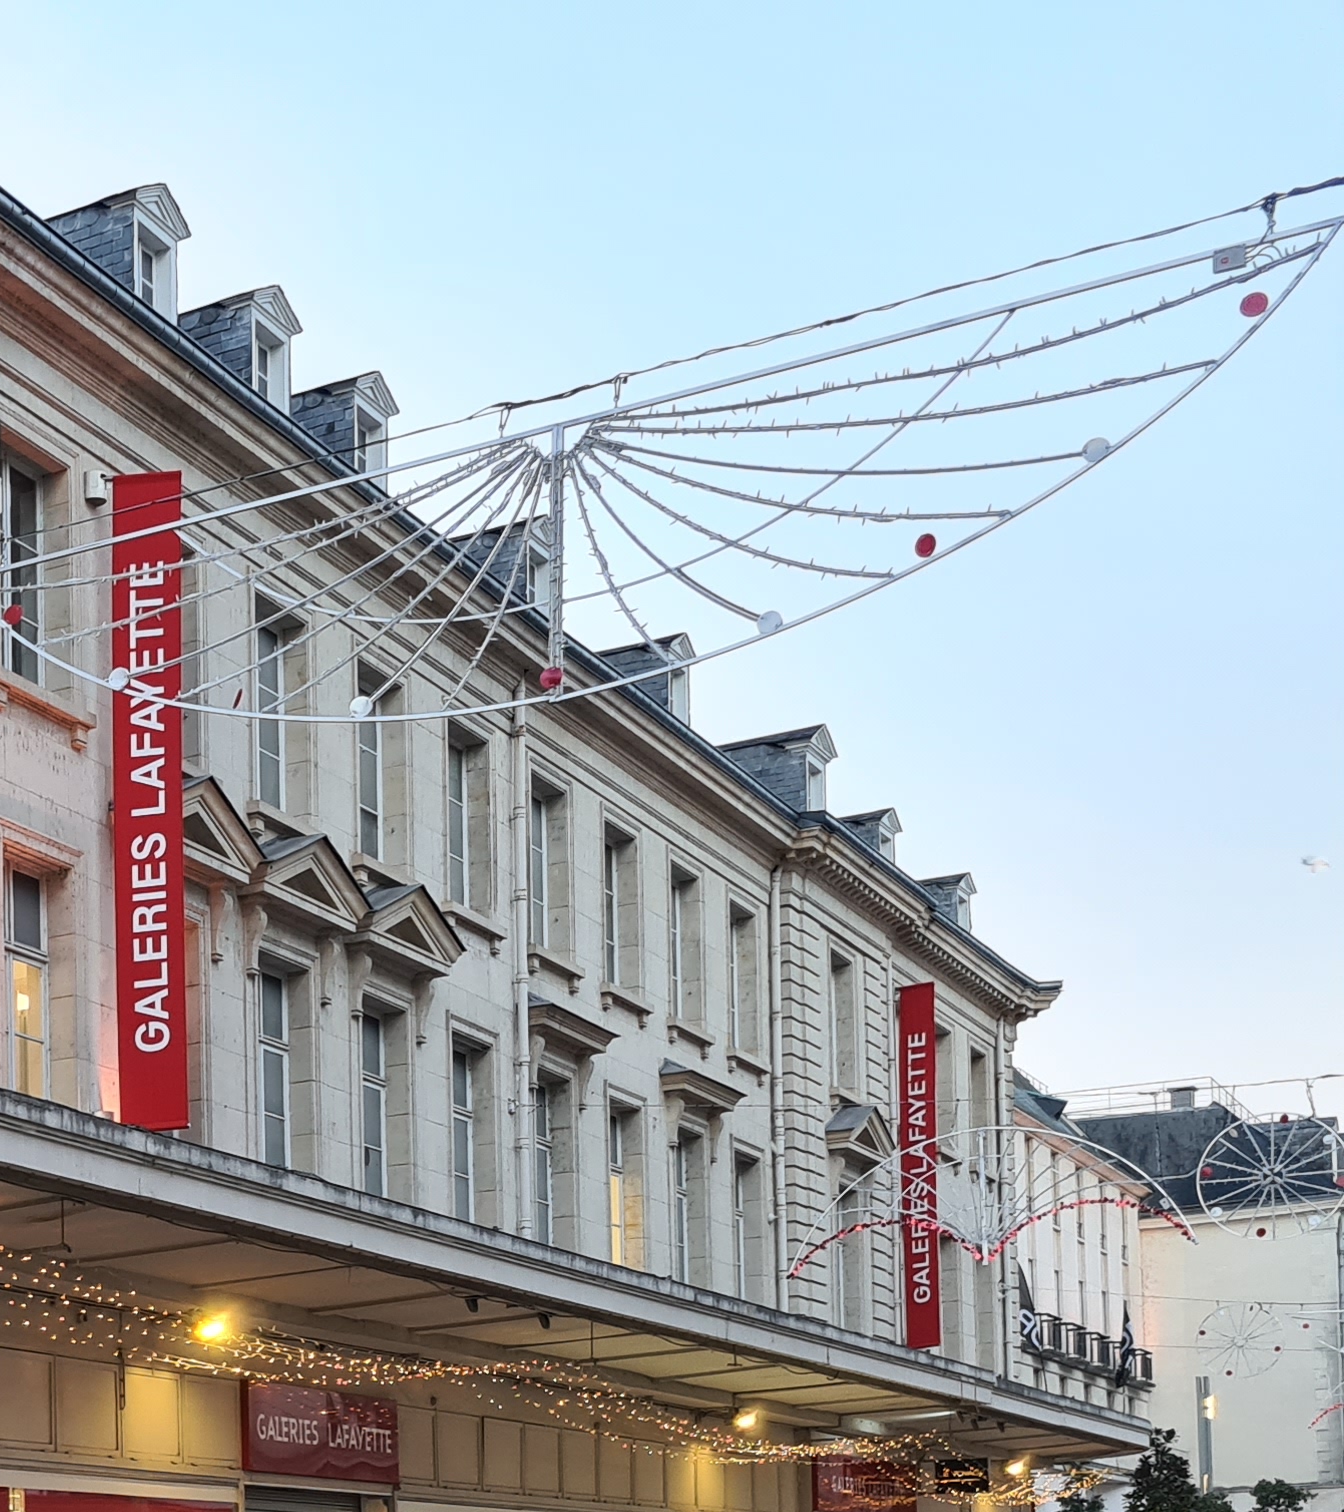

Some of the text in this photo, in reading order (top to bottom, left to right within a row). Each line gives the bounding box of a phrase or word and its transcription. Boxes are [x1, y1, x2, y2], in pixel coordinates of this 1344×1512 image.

[129, 560, 171, 1053] GALERIES LAFAYETTE
[908, 1032, 928, 1174] LAFAYETTE
[256, 1413, 392, 1454] GALERIES LAFAYETTE
